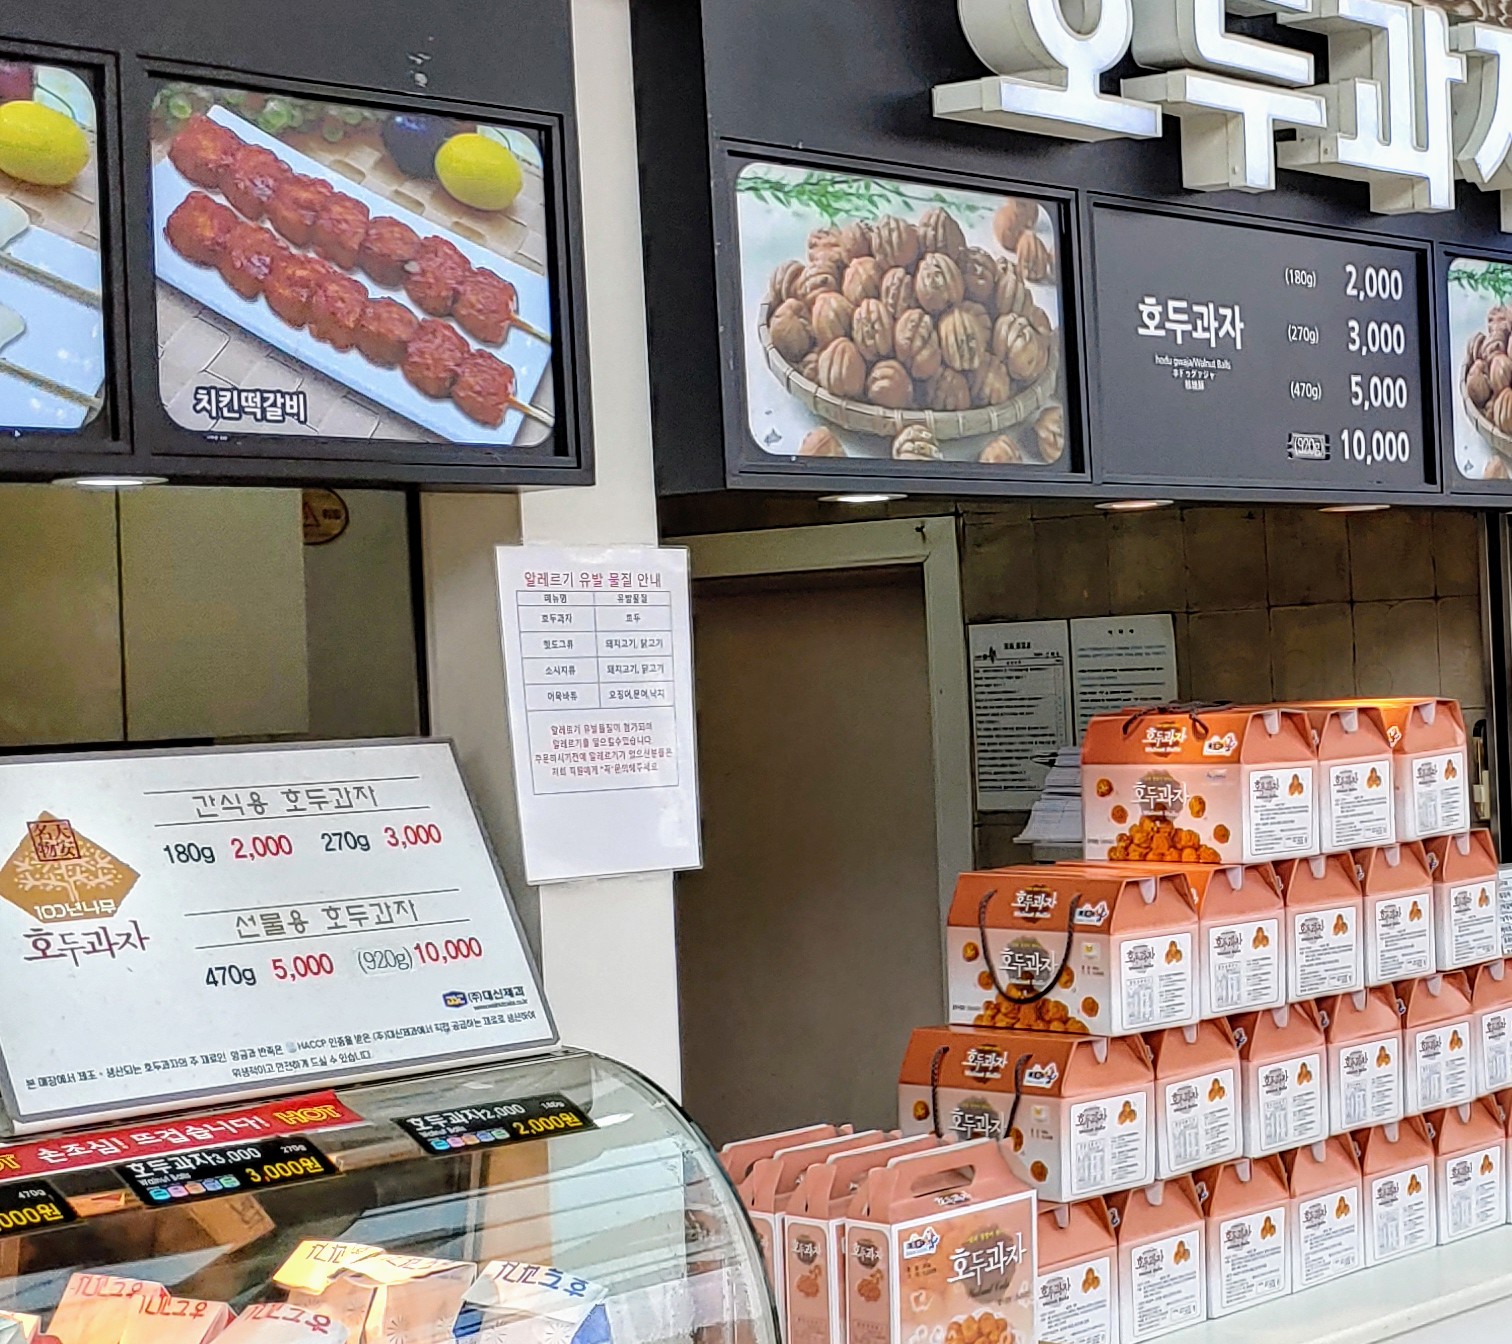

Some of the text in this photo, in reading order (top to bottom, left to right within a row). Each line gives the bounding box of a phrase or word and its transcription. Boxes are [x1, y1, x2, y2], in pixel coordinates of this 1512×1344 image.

[1285, 264, 1403, 301] (180g) 2,000
[1137, 296, 1244, 350] 호두과자
[1288, 319, 1406, 356] (270g) 3,000
[192, 387, 308, 423] 치킨떡갈비
[1290, 374, 1408, 410] (470g) 5,000
[1341, 428, 1410, 465] 10,000
[524, 571, 661, 588] 알레르기 유발 물질 안내
[545, 665, 576, 675] 소시지류
[1142, 727, 1187, 747] 호두과자
[192, 784, 379, 818] 간식용 호두과자
[1130, 781, 1190, 809] 호두과자
[163, 823, 443, 864] 180g 2,000 270g 3,000
[1011, 889, 1057, 912] 호두과자
[235, 899, 420, 939] 선물용 호두과자
[23, 920, 150, 967] 호두과자
[205, 936, 483, 988] 470g 5,000 (920g) 10,000
[998, 947, 1061, 977] 호두과자
[961, 1049, 1008, 1072] 호두과자
[37, 1103, 344, 1163] 손조심! 뜨겁습니다! HOT
[512, 1111, 583, 1136] 2,000원
[948, 1107, 1006, 1137] 호두과자
[281, 1143, 307, 1155] 270g
[245, 1156, 325, 1183] 3,000원
[17, 1187, 47, 1200] 470g
[946, 1231, 1028, 1286] 호두과자
